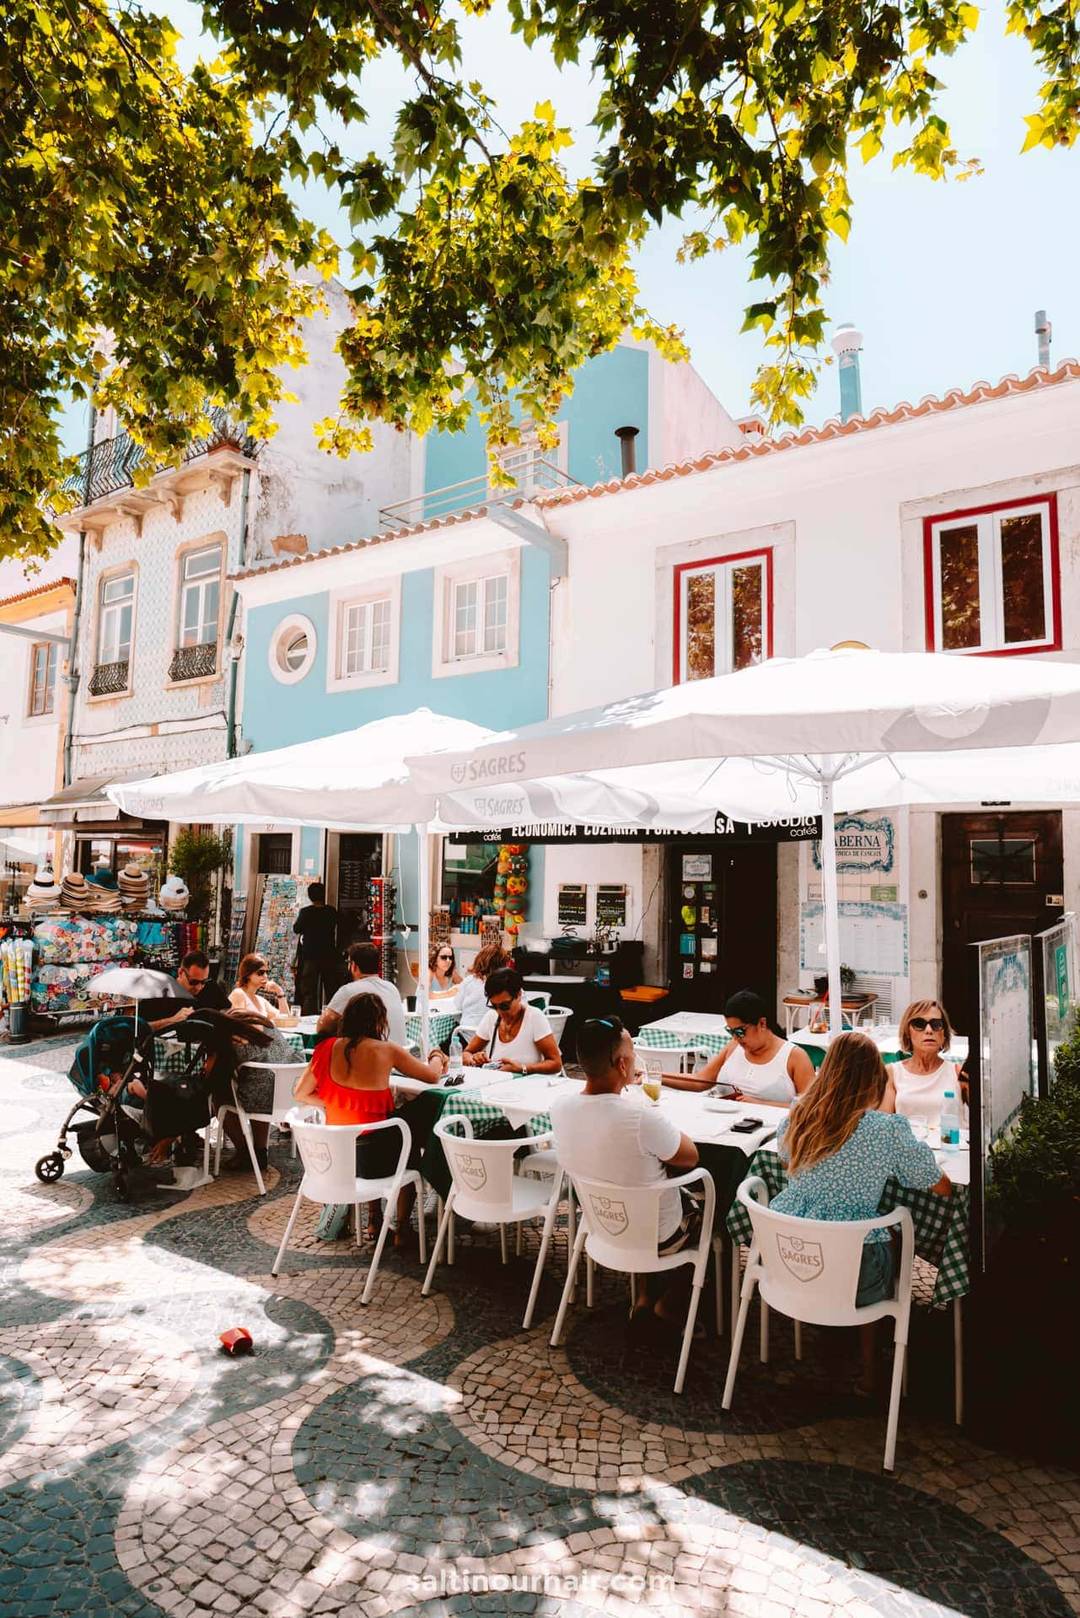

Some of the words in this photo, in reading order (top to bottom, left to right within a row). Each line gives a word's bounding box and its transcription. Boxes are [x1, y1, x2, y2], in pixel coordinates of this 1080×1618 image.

[469, 752, 526, 781] SAGRES
[488, 797, 526, 817] SAGRES
[790, 826, 818, 837] cafés
[835, 835, 880, 847] BERNA
[593, 1205, 626, 1223] SAGRES
[781, 1247, 820, 1267] SAGRES
